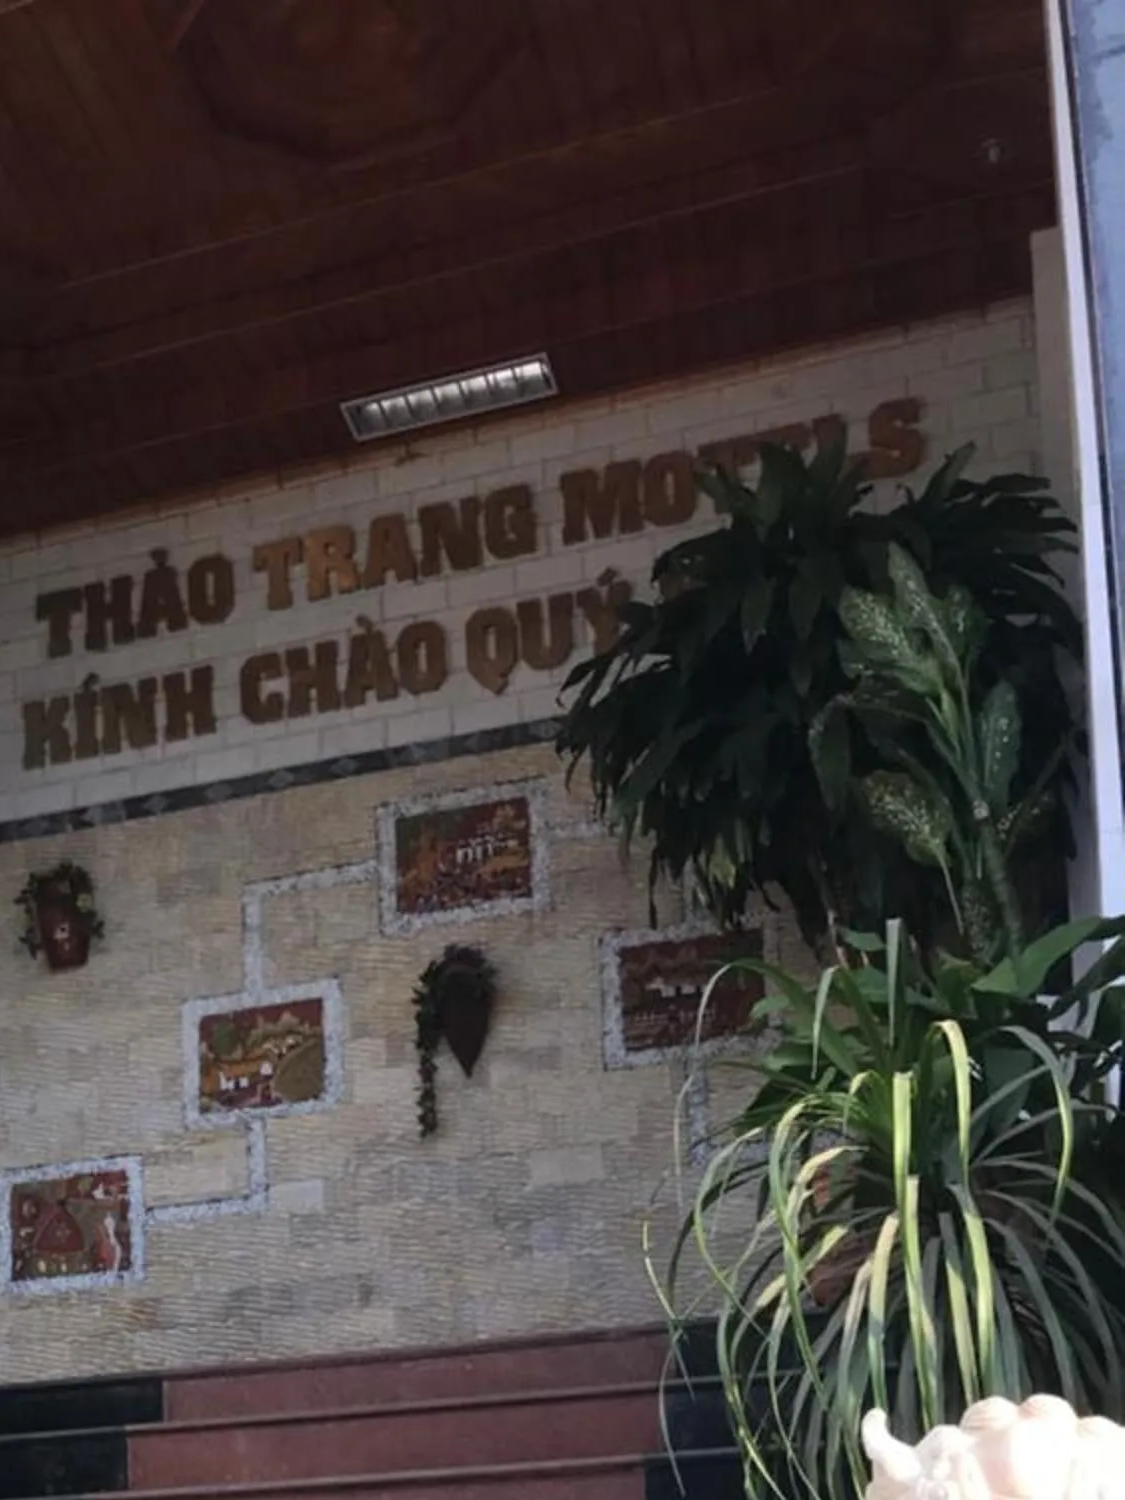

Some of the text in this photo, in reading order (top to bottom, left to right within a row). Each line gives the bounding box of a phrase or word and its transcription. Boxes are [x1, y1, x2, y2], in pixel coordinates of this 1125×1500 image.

[253, 484, 537, 611] TRANG
[22, 567, 633, 770] KÍNH CHÀO QUÝ
